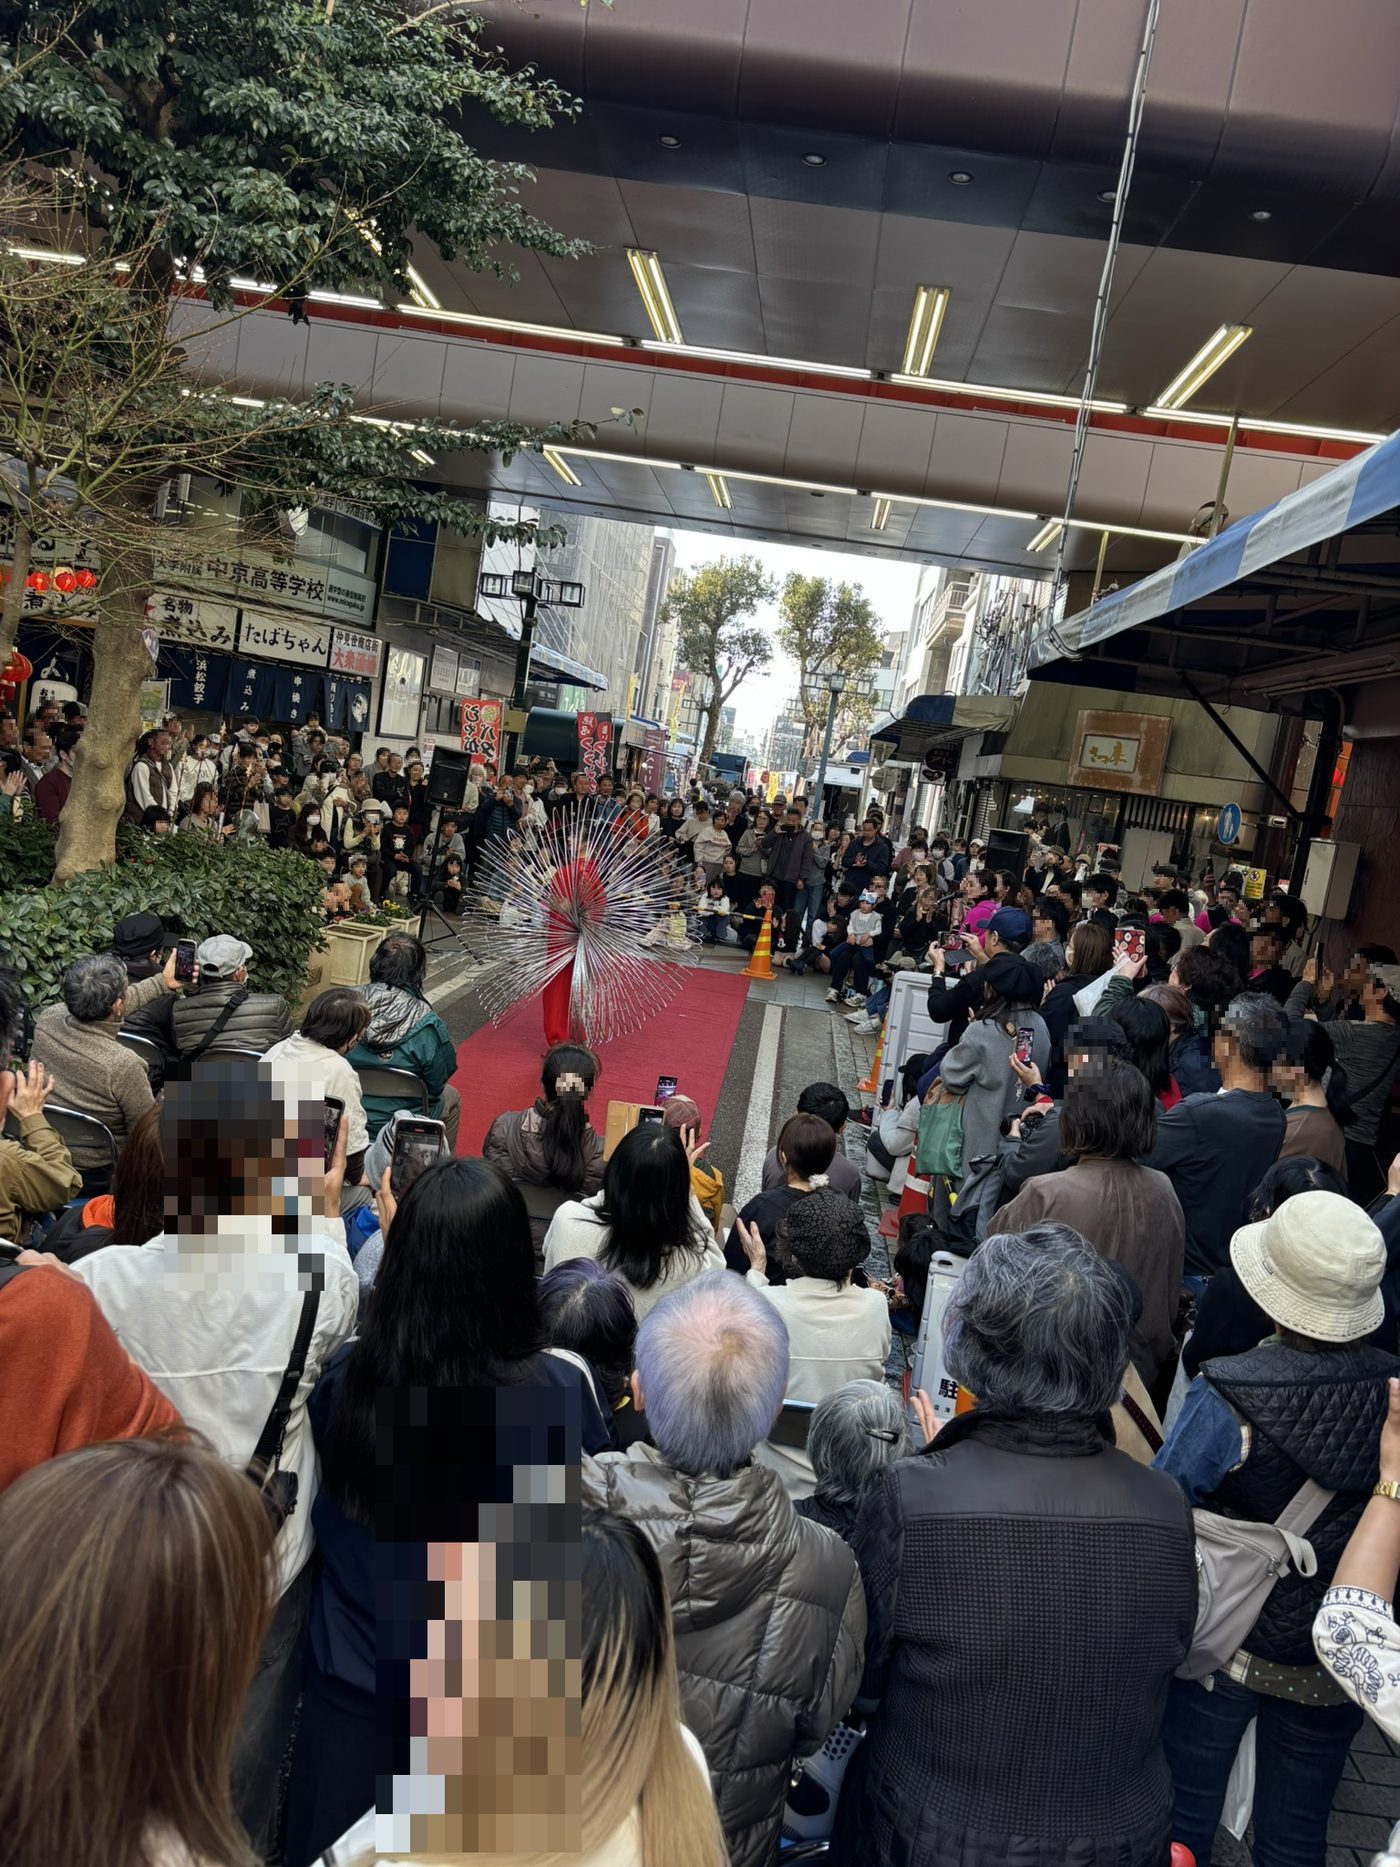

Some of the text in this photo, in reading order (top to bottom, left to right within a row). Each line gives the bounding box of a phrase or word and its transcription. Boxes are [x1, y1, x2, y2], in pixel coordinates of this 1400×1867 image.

[161, 597, 194, 615] 名物
[245, 624, 328, 656] たばちゃん
[335, 630, 379, 654] 仲見世商店街
[193, 660, 208, 705] 浜松餃子
[239, 668, 257, 711] 煮込み
[290, 675, 302, 719] 串焼き
